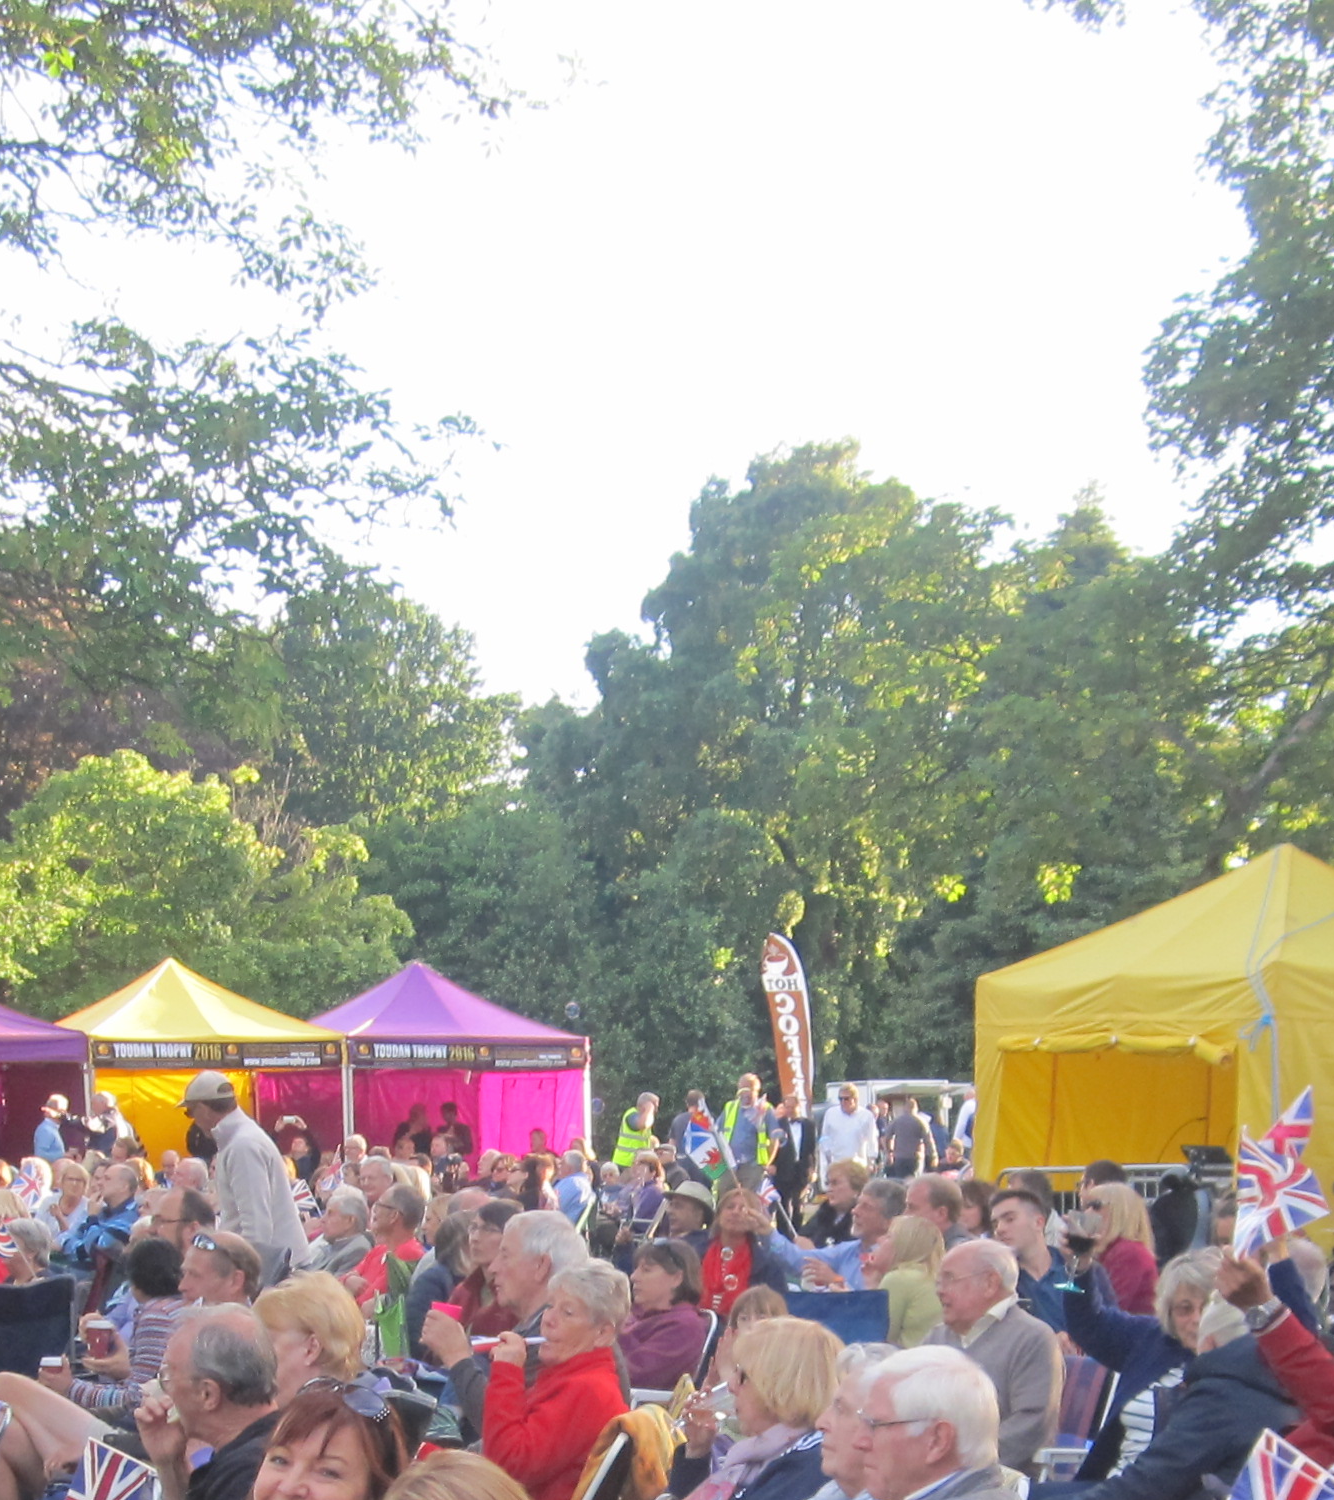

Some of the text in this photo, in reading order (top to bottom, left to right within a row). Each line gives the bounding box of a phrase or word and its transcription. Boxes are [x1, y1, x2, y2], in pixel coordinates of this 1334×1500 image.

[113, 1043, 223, 1061] YOUDAN TROPHY 2016
[373, 1043, 476, 1062] YOUDAN TROPHY 2016
